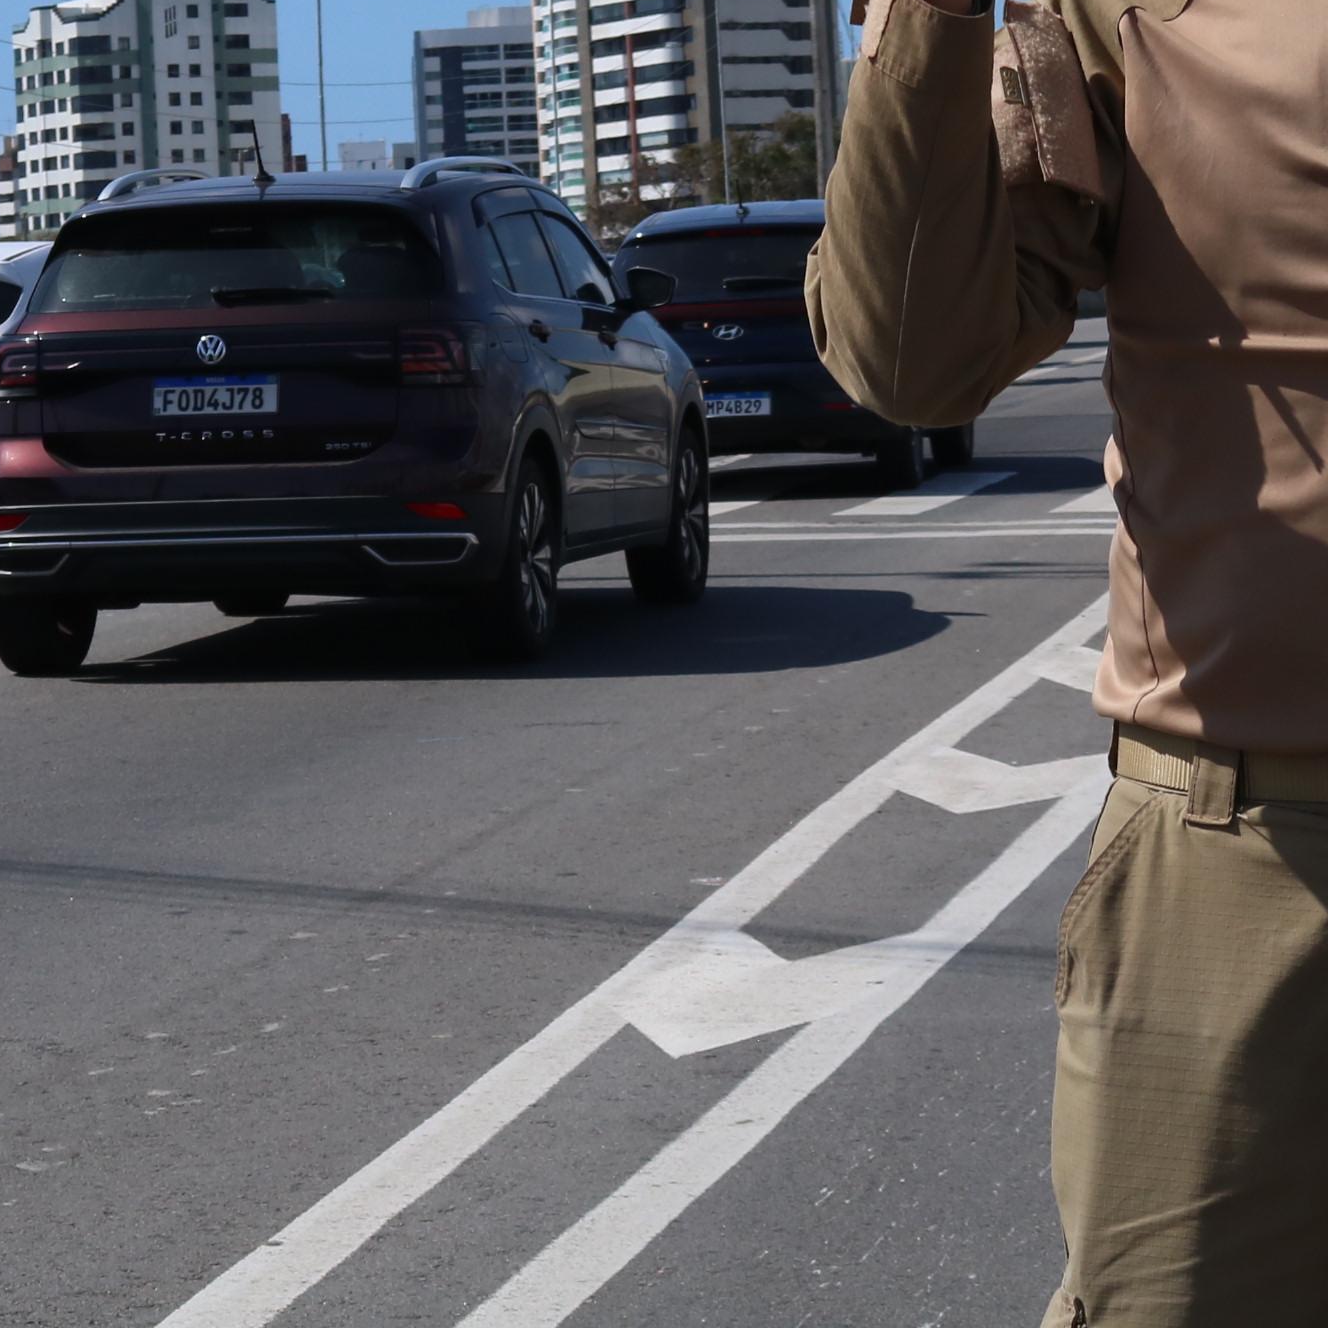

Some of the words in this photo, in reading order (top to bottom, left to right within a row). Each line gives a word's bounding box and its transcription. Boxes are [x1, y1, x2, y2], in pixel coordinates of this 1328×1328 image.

[162, 387, 264, 413] FOD4J78
[706, 400, 762, 414] MP4B29
[155, 429, 275, 442] T-CROSS
